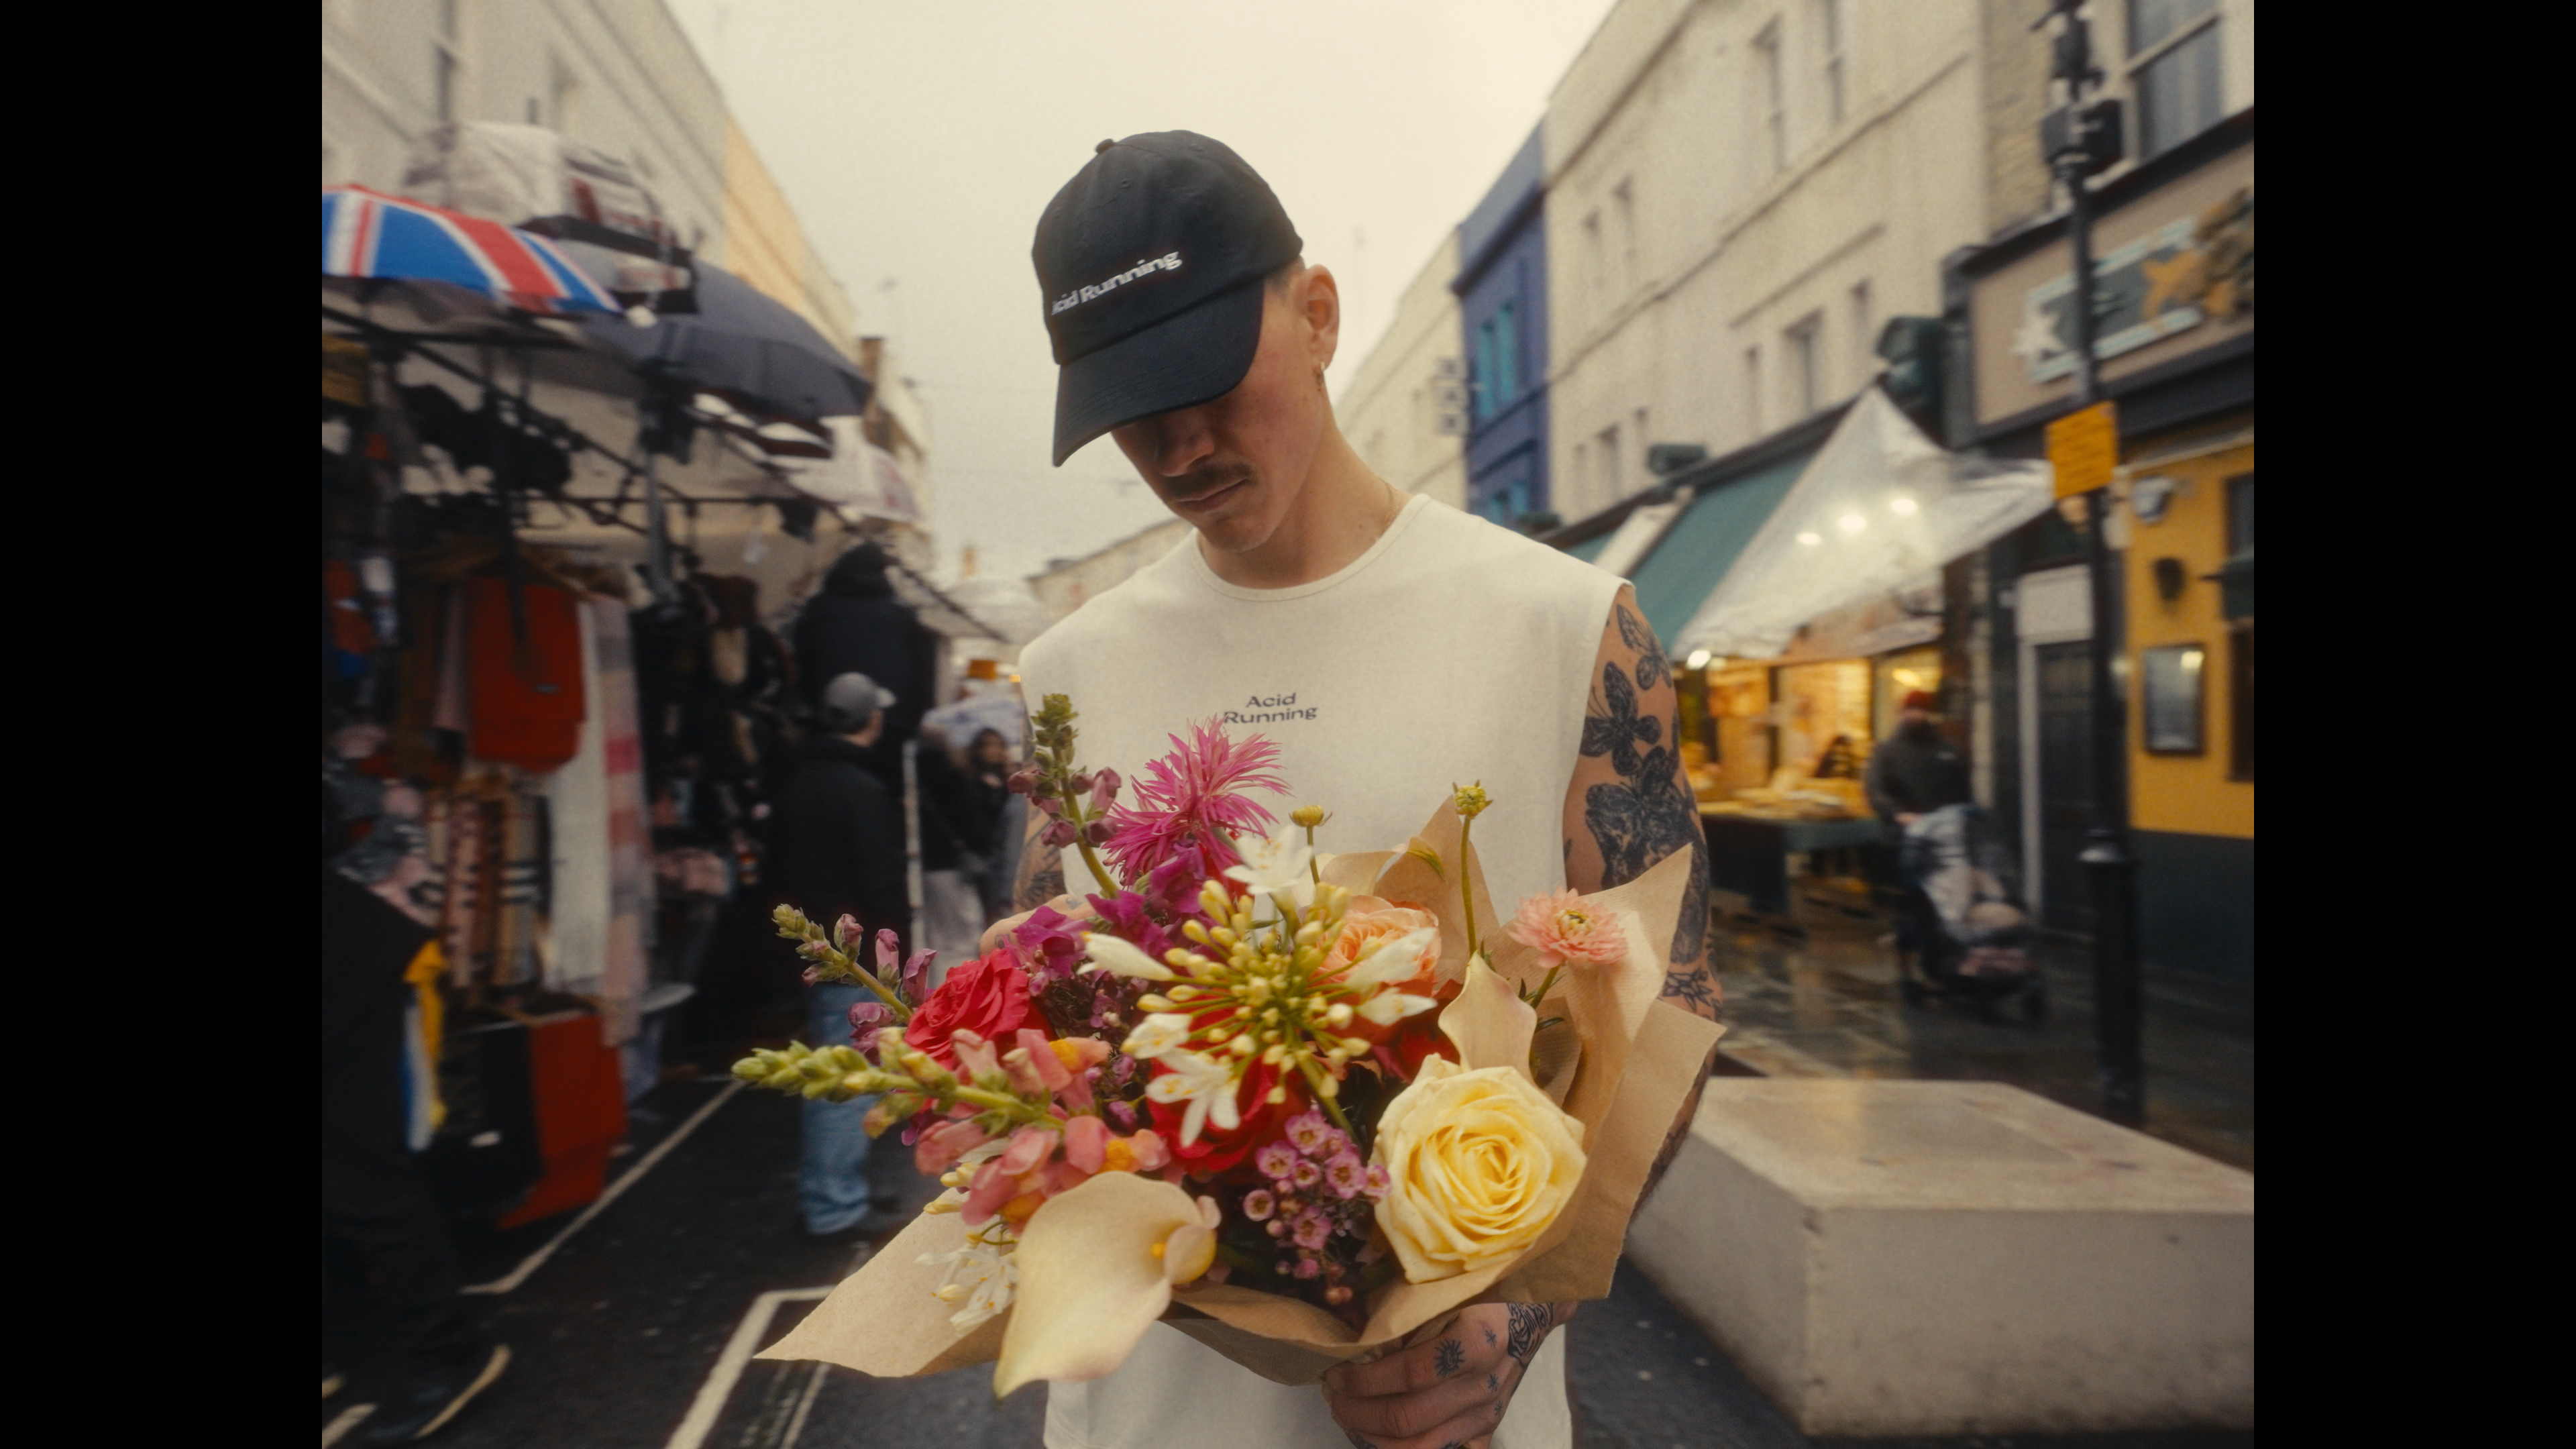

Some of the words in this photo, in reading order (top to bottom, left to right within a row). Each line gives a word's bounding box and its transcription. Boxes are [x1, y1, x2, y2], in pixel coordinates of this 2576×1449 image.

[1079, 251, 1183, 303] Running
[1246, 692, 1296, 708] Acid
[1223, 707, 1318, 723] Running
